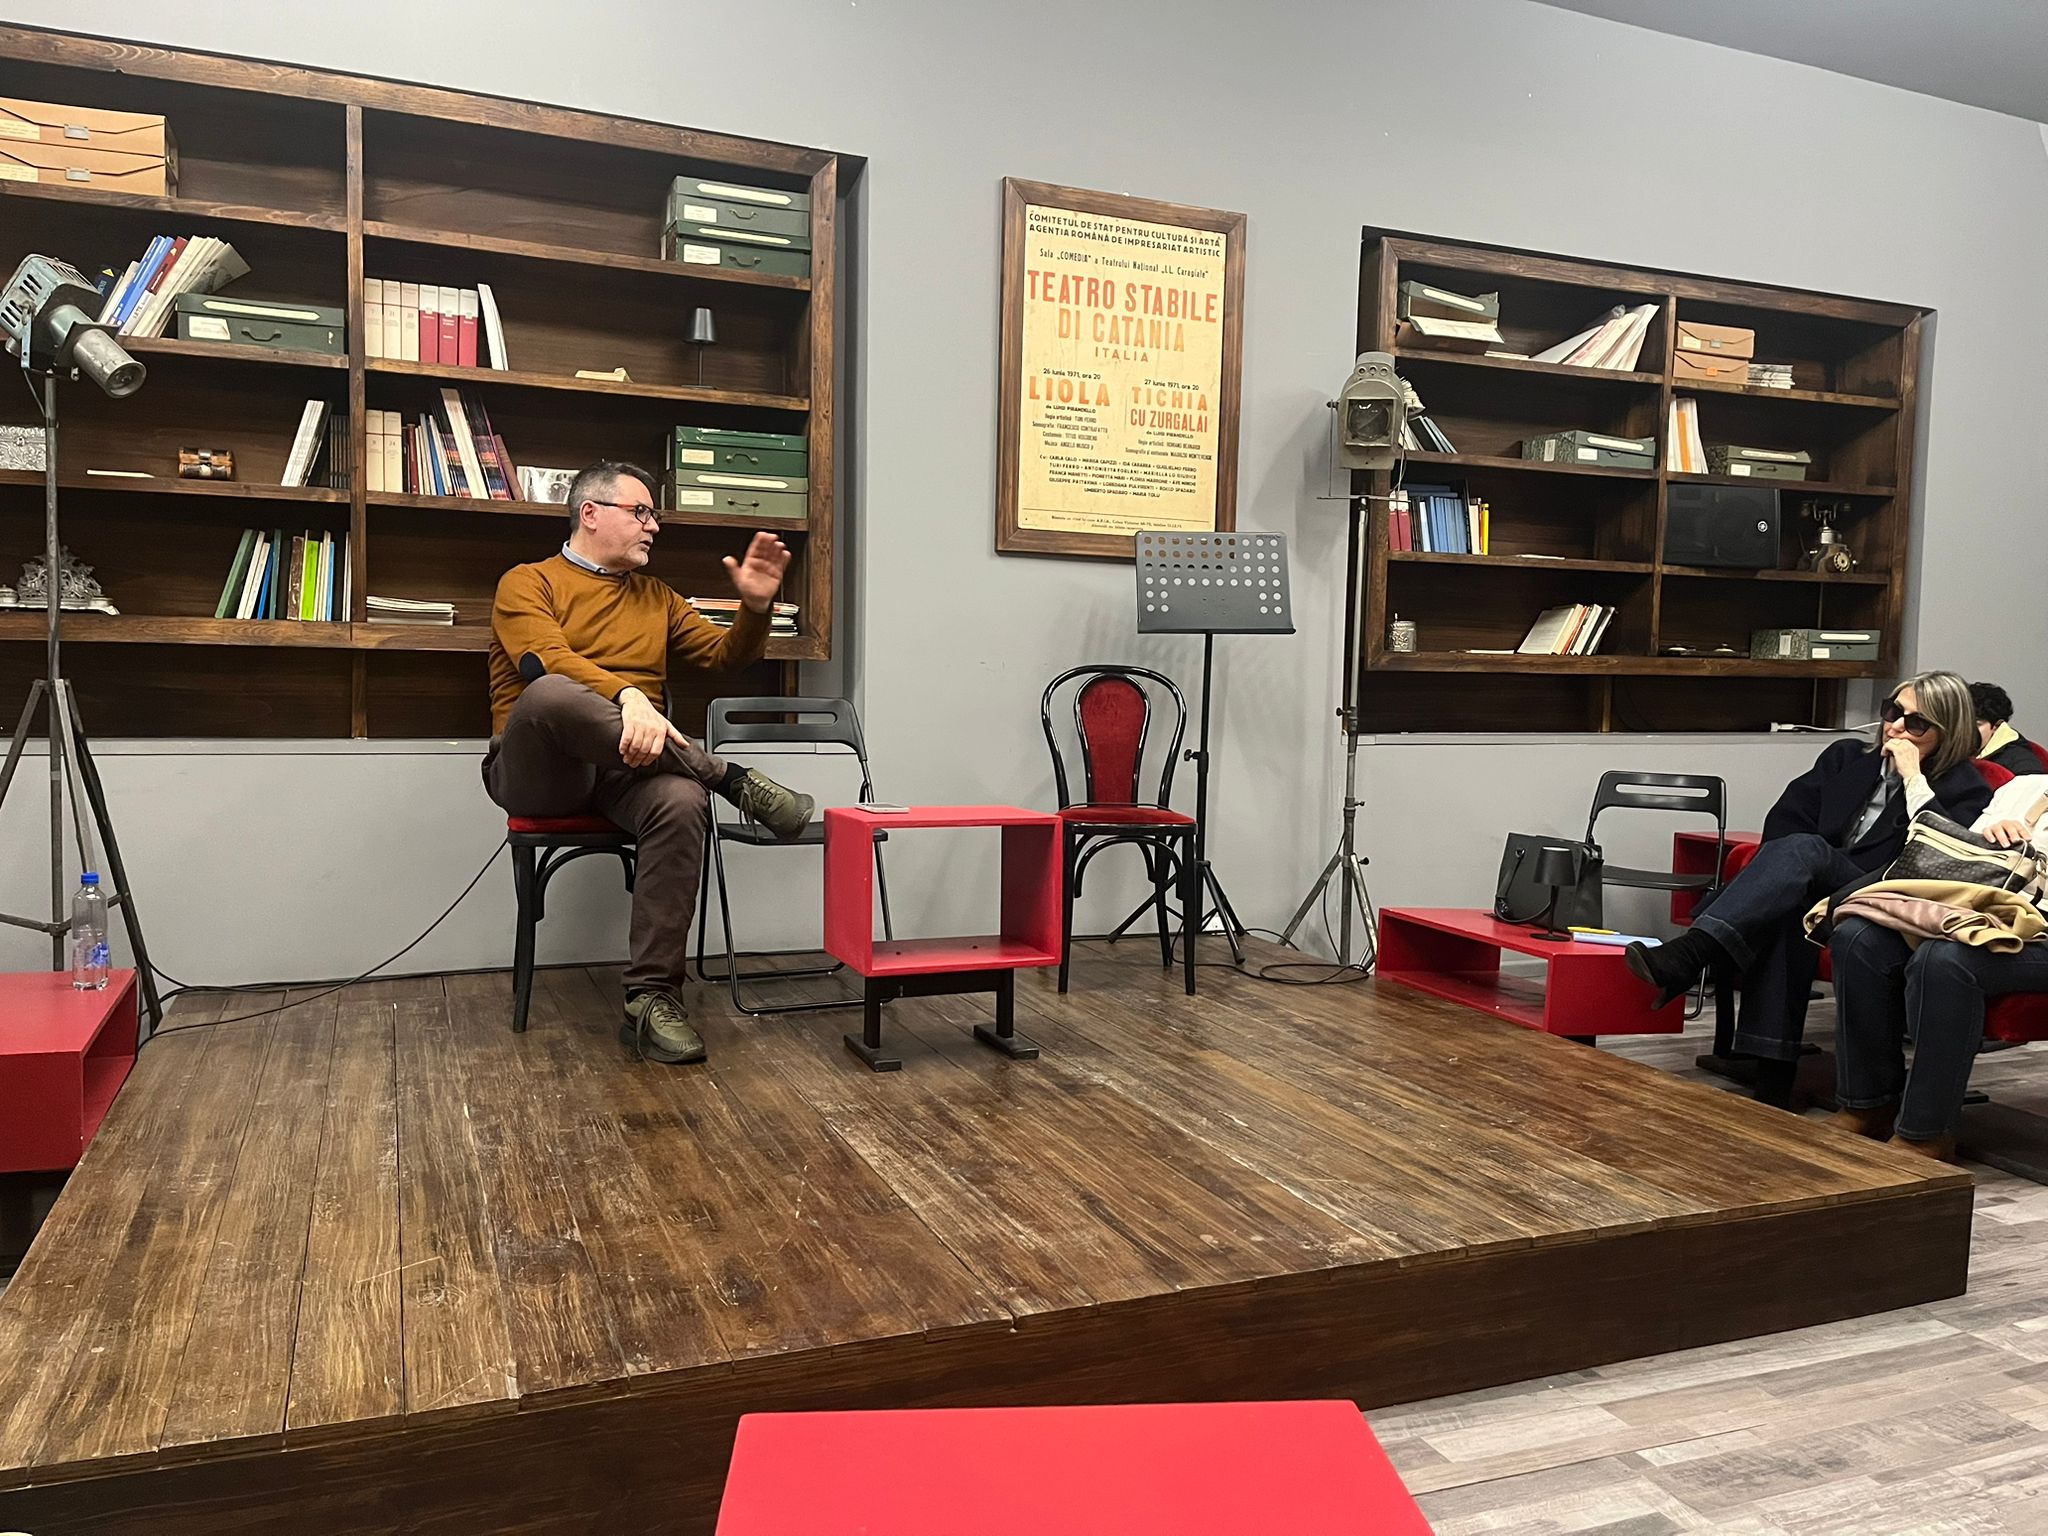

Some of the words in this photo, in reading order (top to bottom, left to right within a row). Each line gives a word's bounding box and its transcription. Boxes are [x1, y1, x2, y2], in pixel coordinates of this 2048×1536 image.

[1029, 213, 1079, 227] COMITETUL
[1080, 221, 1092, 230] DE
[1093, 222, 1114, 232] STAT
[1115, 225, 1150, 238] PENTRU
[1040, 248, 1054, 258] Sala
[1101, 256, 1130, 269] Teatrului
[1111, 235, 1123, 245] DE
[1124, 237, 1181, 252] IMPRESARIAT
[1183, 246, 1220, 257] ARTISTIC
[1027, 269, 1115, 309] TEATRO
[1125, 282, 1217, 323] STABILE
[1058, 307, 1081, 341] DI
[1092, 312, 1185, 352] CATANIA
[1095, 346, 1149, 362] ITALIA
[1029, 375, 1110, 407] LIOLA
[1131, 386, 1207, 411] TICHIA
[1130, 408, 1146, 427] CU
[1149, 410, 1208, 433] ZURGALAI
[1084, 465, 1116, 473] ANTONIETTA
